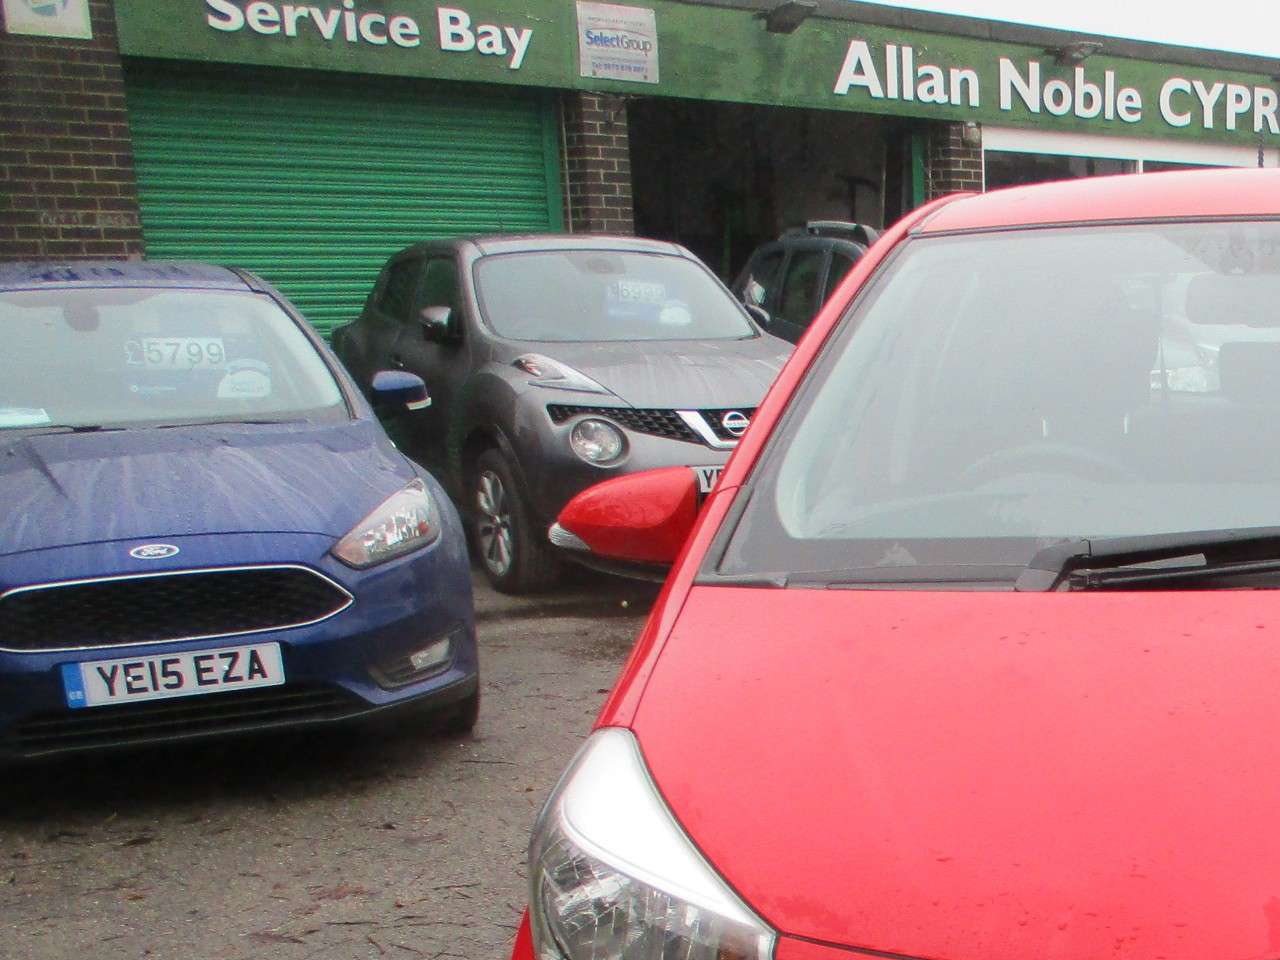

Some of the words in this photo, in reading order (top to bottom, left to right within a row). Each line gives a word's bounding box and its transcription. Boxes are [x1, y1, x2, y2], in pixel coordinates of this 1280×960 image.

[206, 0, 421, 47] Service
[436, 7, 533, 69] Bay
[832, 39, 980, 108] Allan
[998, 56, 1143, 124] Noble
[124, 339, 224, 366] £5799
[96, 657, 185, 697] YE15
[193, 649, 268, 686] EZA
